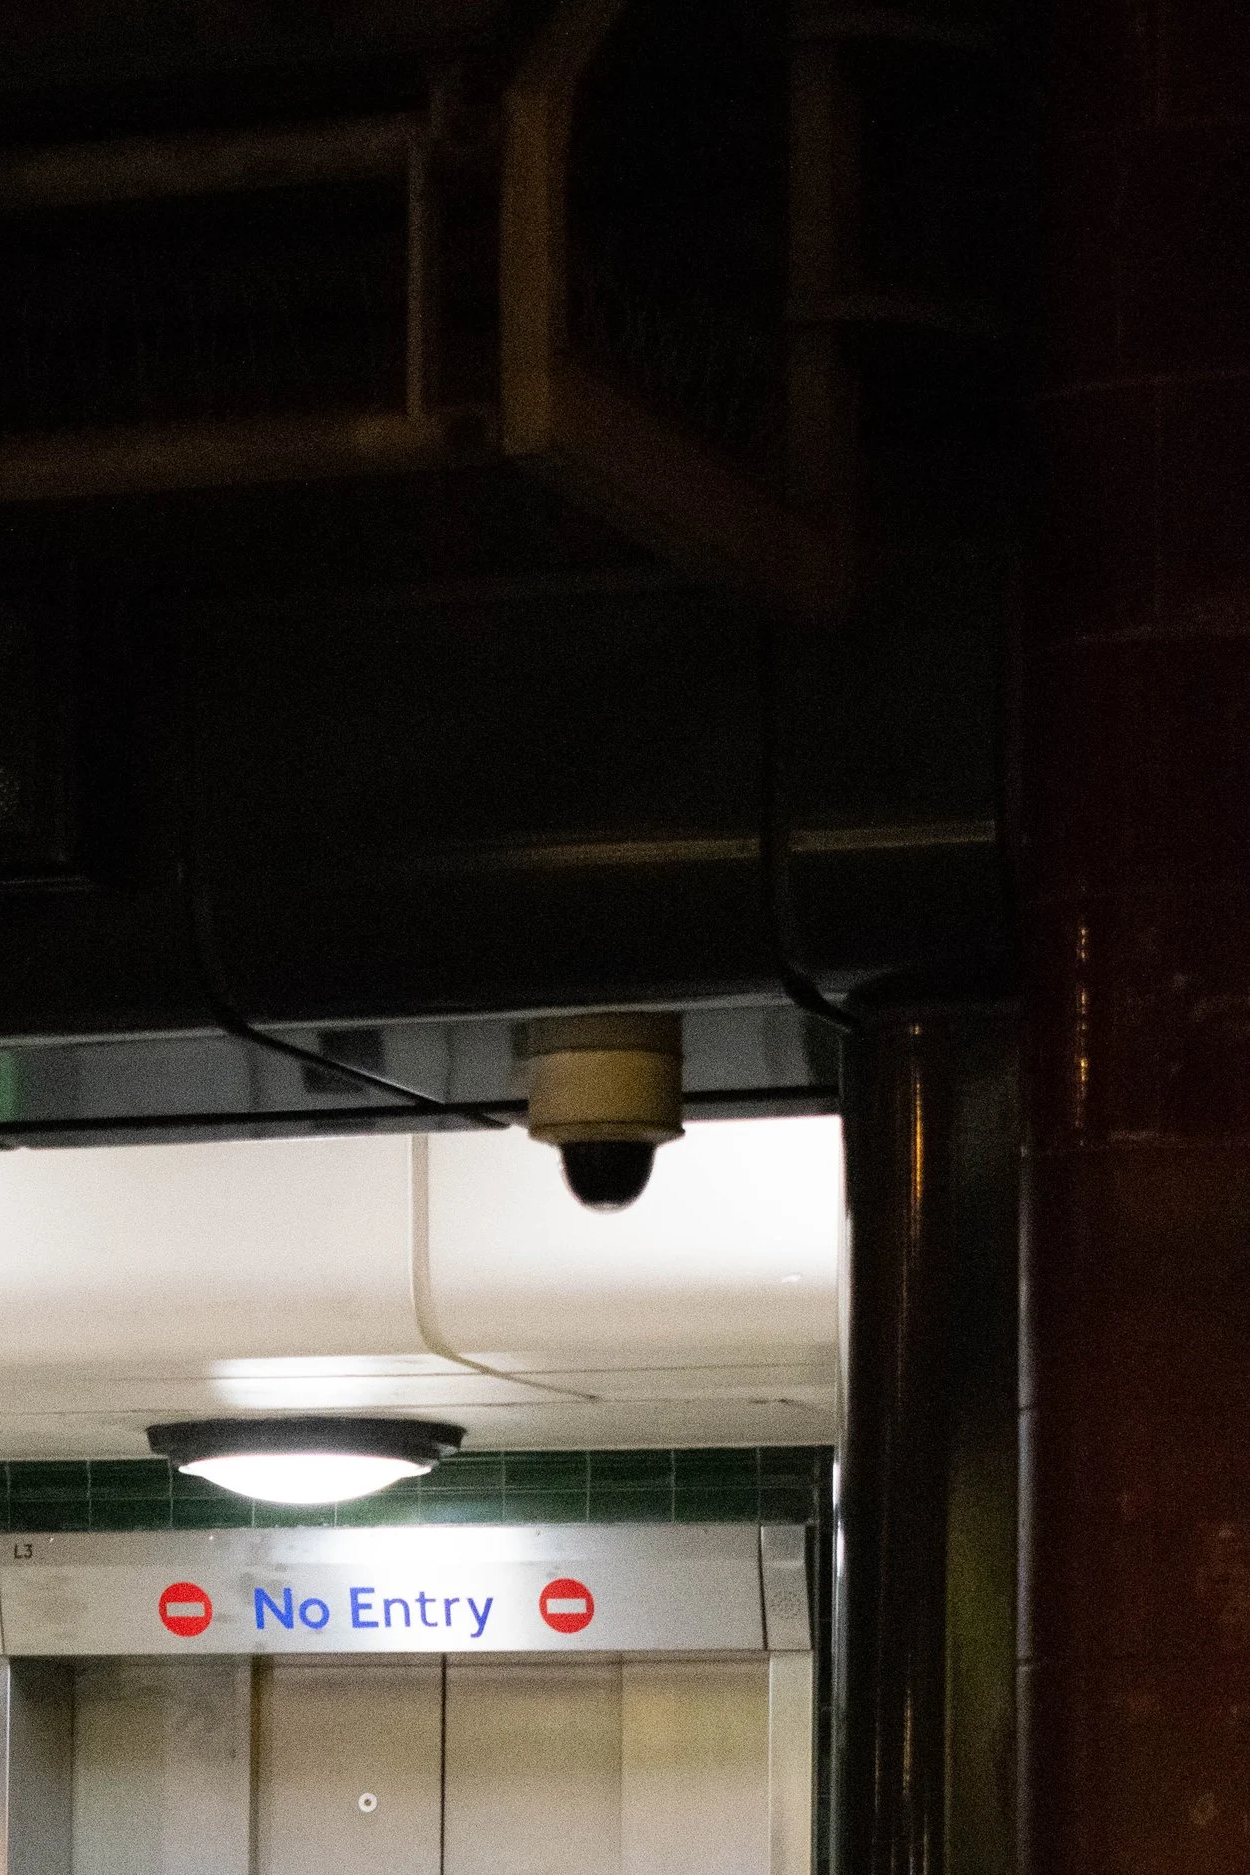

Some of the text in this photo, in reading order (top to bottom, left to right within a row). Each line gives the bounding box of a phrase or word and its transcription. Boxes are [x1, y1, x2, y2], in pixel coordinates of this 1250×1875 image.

[13, 1542, 34, 1559] L3
[253, 1585, 495, 1639] No Entry
